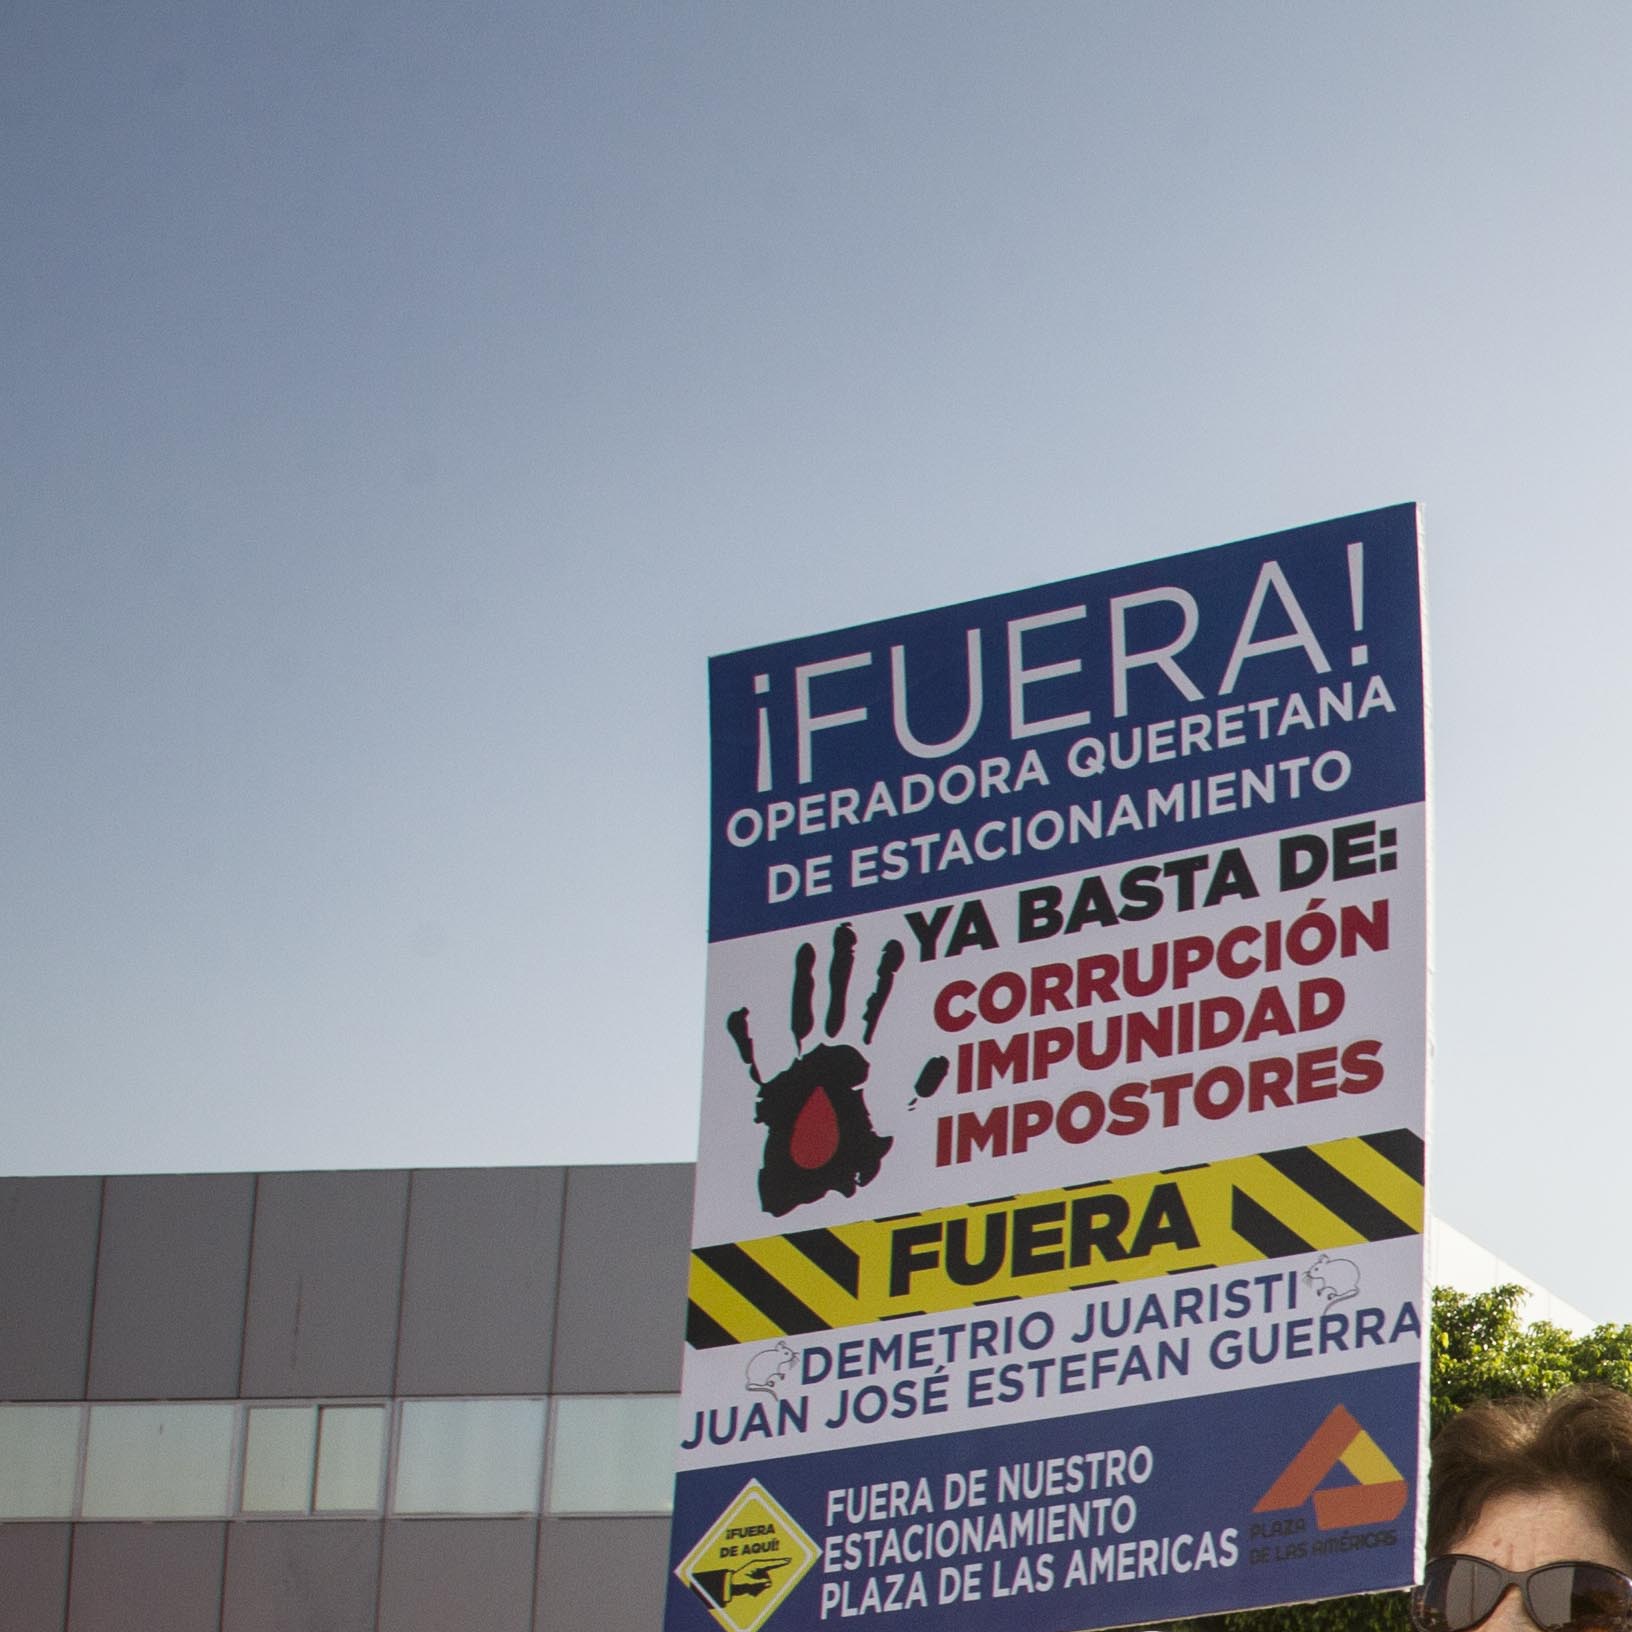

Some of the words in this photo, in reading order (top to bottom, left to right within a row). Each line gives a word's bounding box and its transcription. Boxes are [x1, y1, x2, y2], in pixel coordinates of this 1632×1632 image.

[755, 542, 1368, 792] ¡FUERA!
[727, 750, 1049, 847] OPERADORA
[1068, 675, 1396, 777] QUERETANA
[769, 855, 832, 903] DE
[852, 751, 1351, 887] ESTACIONAMIENTO
[904, 900, 999, 962] YA
[1018, 848, 1259, 943] BASTA
[1280, 821, 1397, 892] DE:
[934, 898, 1388, 1032] CORRUPCIÓN
[957, 978, 1345, 1094] IMPUNIDAD
[936, 1040, 1384, 1167] IMPOSTORES
[889, 1182, 1201, 1296] FUERA
[681, 1396, 808, 1449] JUAN
[825, 1365, 949, 1428] JOSÉ
[968, 1338, 1189, 1408] ESTEFAN
[1210, 1302, 1421, 1369] GUERRA
[802, 1312, 1054, 1385] DEMETRIO
[1071, 1271, 1297, 1343] JUARISTI
[726, 1524, 775, 1540] ¡FUERA
[824, 1495, 1136, 1573] ESTACIONAMIENTO
[827, 1478, 933, 1526] FUERA
[945, 1469, 987, 1510] DE
[998, 1446, 1153, 1502] NUESTRO
[720, 1546, 737, 1558] DE
[821, 1571, 927, 1619] PLAZA
[939, 1563, 982, 1604] DE
[993, 1554, 1054, 1597] LAS
[1064, 1528, 1238, 1588] AMERICAS
